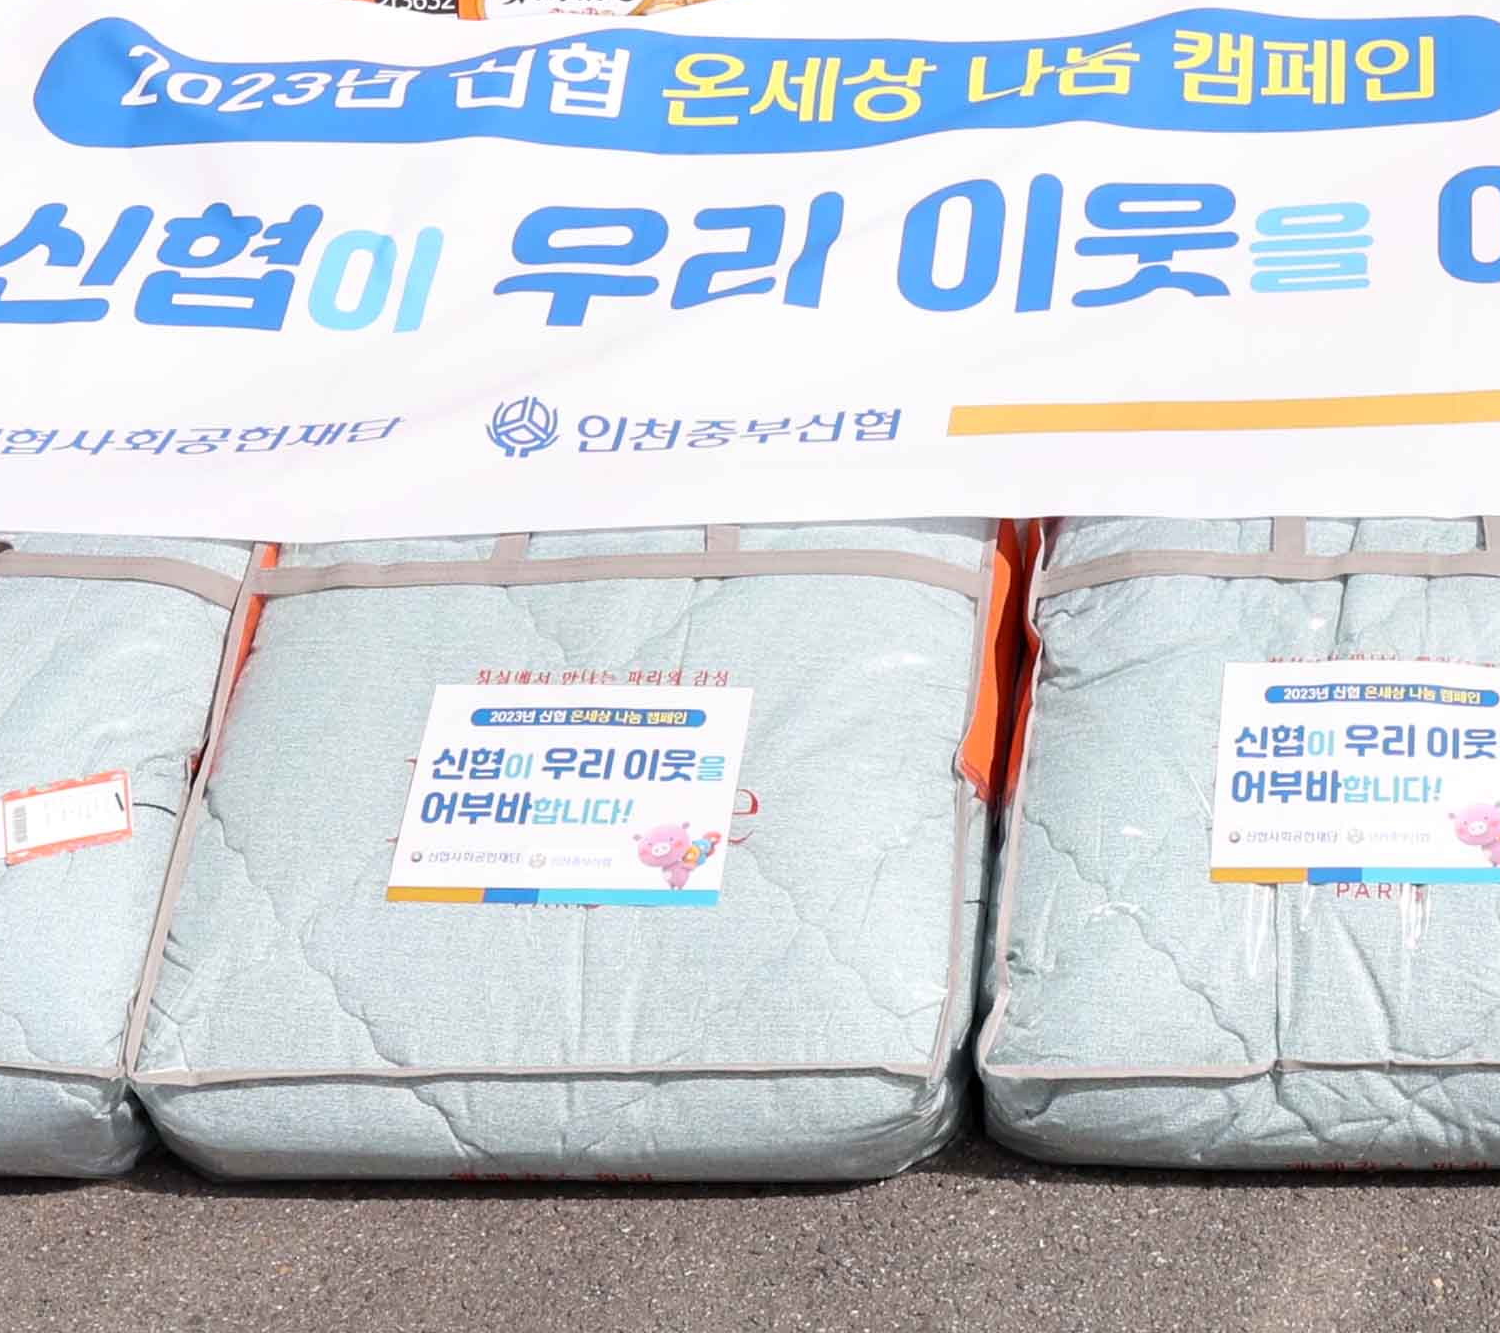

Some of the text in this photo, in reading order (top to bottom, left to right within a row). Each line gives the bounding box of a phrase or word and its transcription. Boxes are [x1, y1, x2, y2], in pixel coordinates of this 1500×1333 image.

[124, 24, 1441, 124] 2023년 신협 온세상 나눔 캠페인
[493, 191, 844, 326] 우리
[897, 173, 1373, 313] 이웃을
[578, 409, 901, 452] 인천중부신협
[488, 709, 688, 726] 2023년 신협 온세상 나눔 캠페인
[1235, 725, 1334, 758] 신협이
[1345, 725, 1415, 757] 우리
[433, 747, 724, 781] 신협이 우리 이웃을
[1232, 770, 1442, 804] 어부바합니다!
[421, 792, 633, 825] 어부바합니다!
